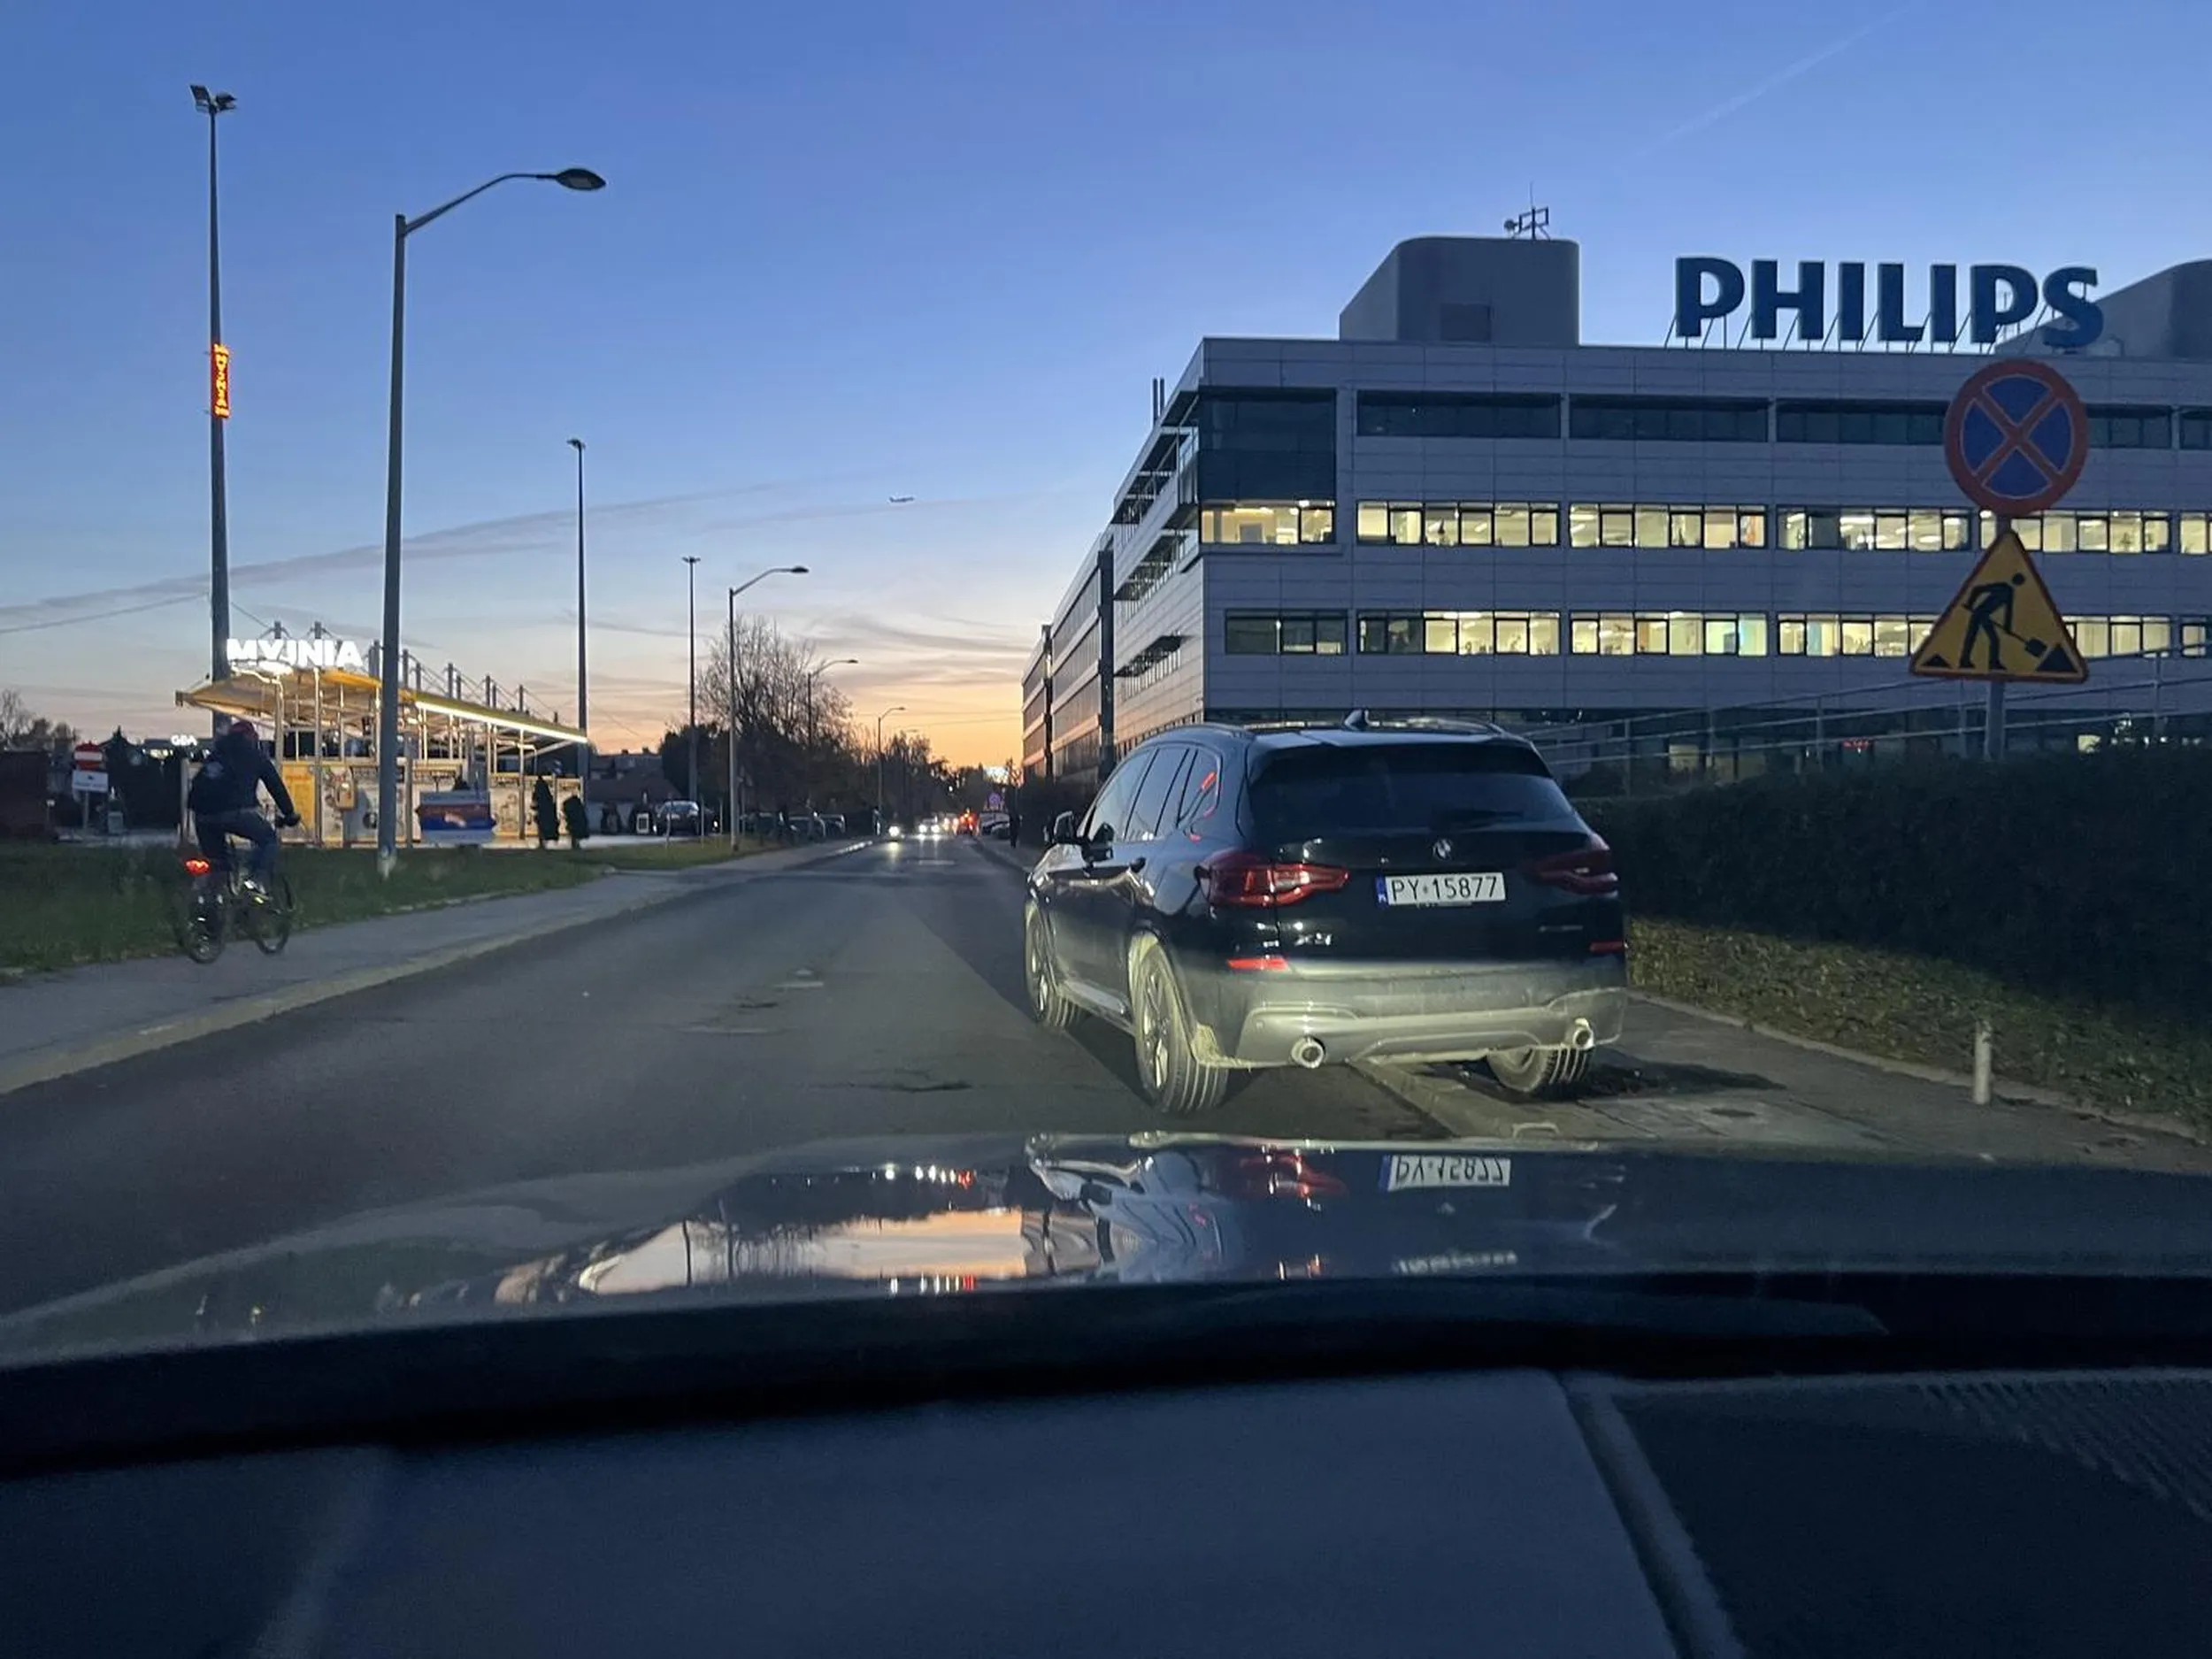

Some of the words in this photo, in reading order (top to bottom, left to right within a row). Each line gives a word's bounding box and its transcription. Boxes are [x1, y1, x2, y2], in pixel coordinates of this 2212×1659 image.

[1675, 257, 2105, 349] PHILIPS
[227, 638, 364, 667] MYJNIA
[1391, 877, 1418, 901] PY
[1432, 875, 1497, 900] 15877
